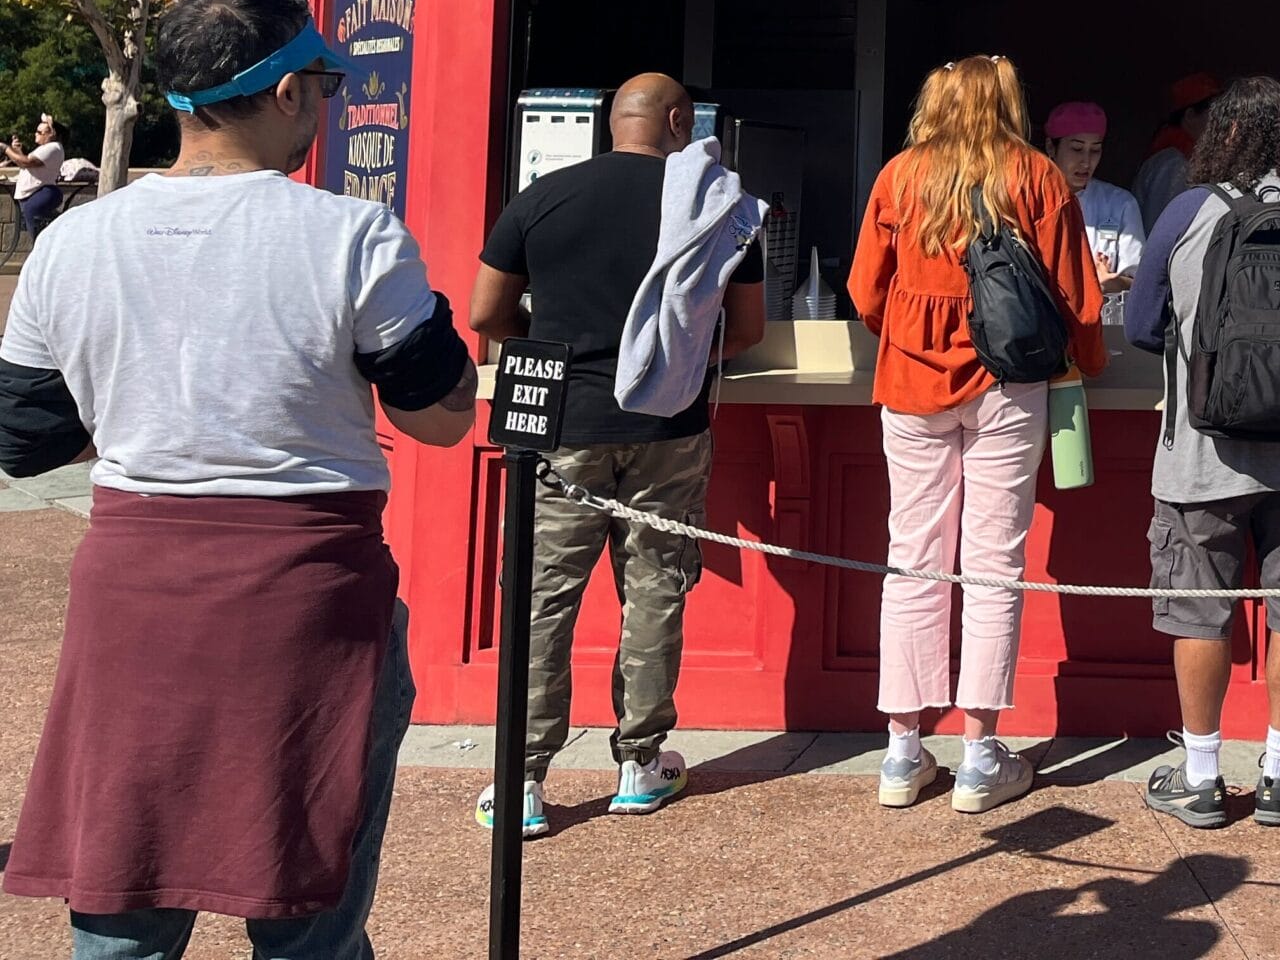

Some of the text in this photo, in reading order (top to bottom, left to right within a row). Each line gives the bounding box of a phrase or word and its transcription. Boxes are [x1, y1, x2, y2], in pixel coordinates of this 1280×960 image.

[347, 103, 399, 130] TRADITIONNEL
[348, 131, 395, 173] KIOSQUE DE
[504, 355, 564, 380] PLEASE
[512, 384, 548, 407] EXIT
[504, 410, 548, 435] HERE
[660, 766, 681, 781] HOKA
